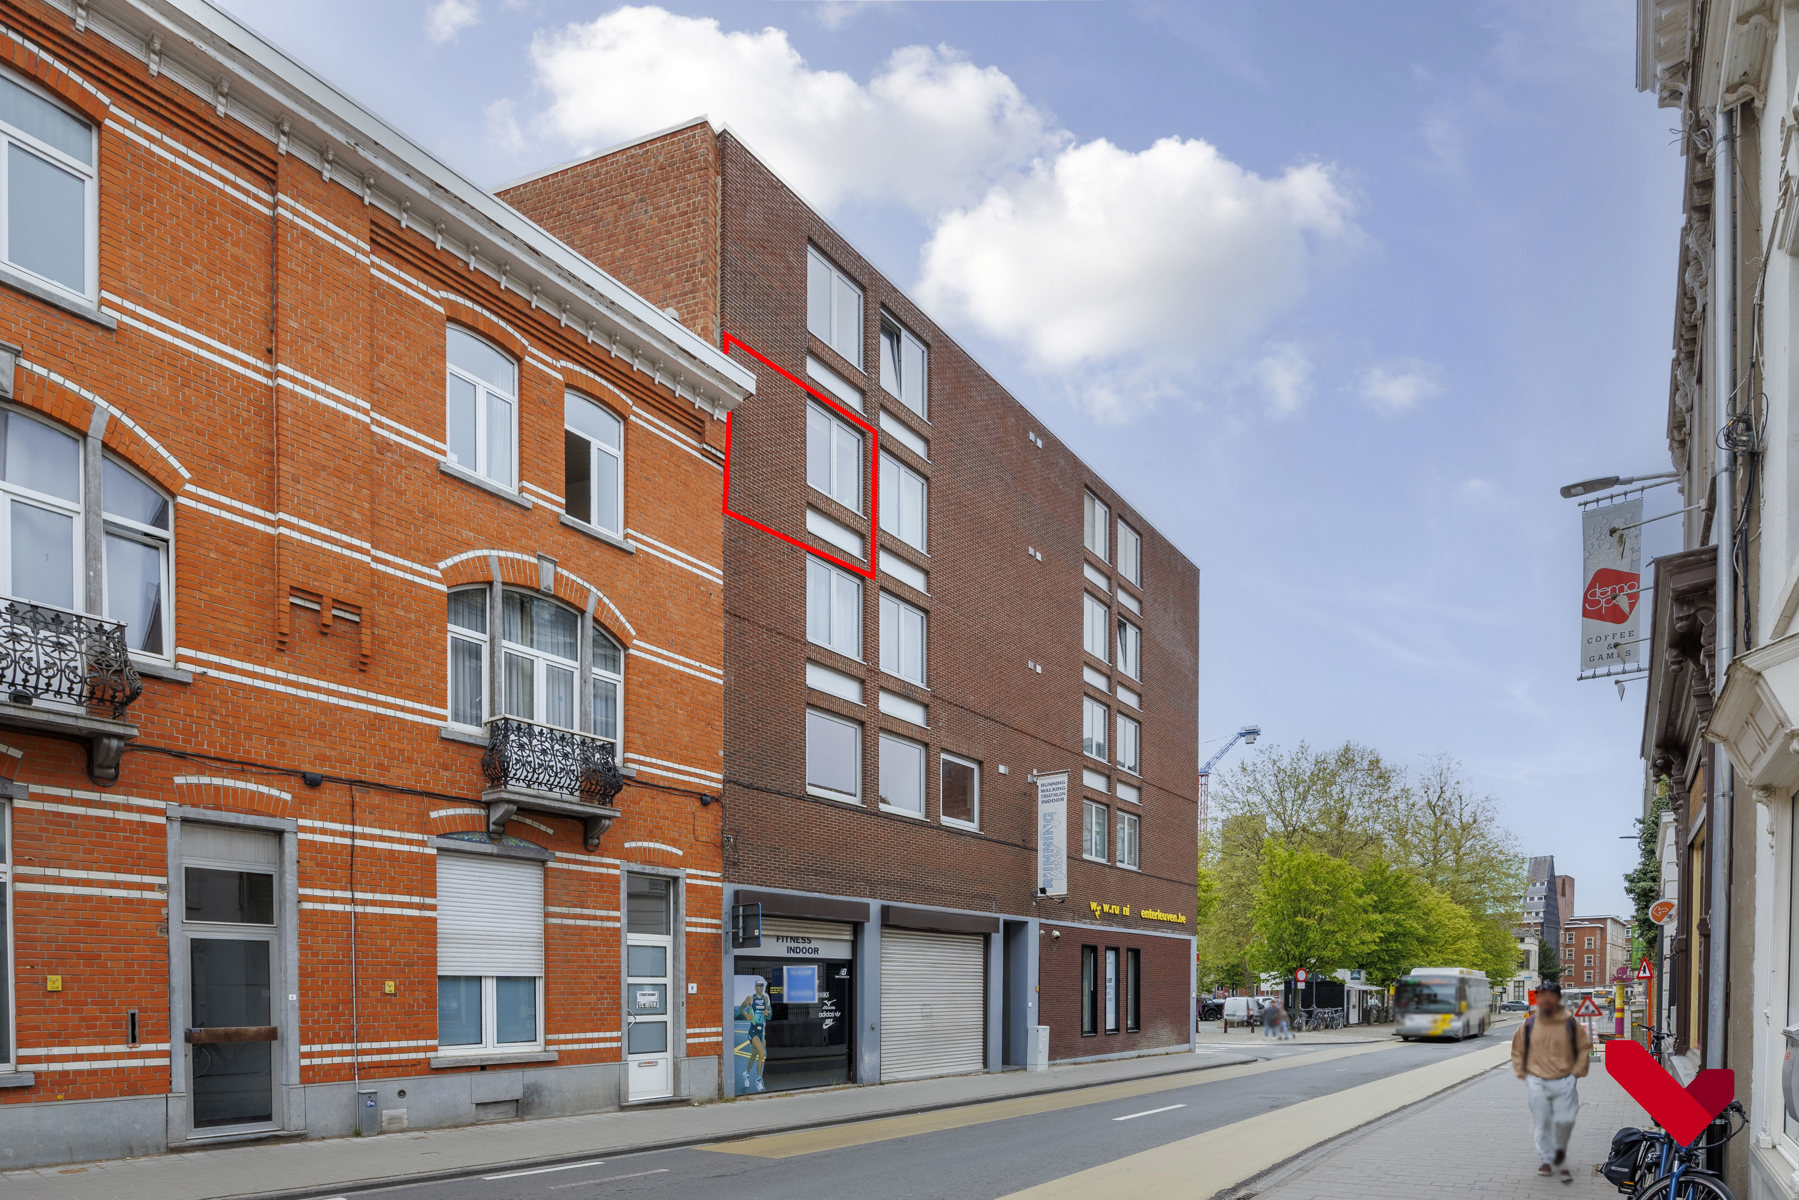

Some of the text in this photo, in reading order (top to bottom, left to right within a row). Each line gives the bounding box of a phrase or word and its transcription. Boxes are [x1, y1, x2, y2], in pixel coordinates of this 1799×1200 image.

[1587, 630, 1634, 644] COFFEE
[1040, 780, 1066, 788] RUNNING
[1043, 811, 1054, 888] RUNNING
[1140, 908, 1187, 924] enterleuven.be
[776, 936, 812, 944] FITNESS
[786, 946, 820, 955] INDOOR
